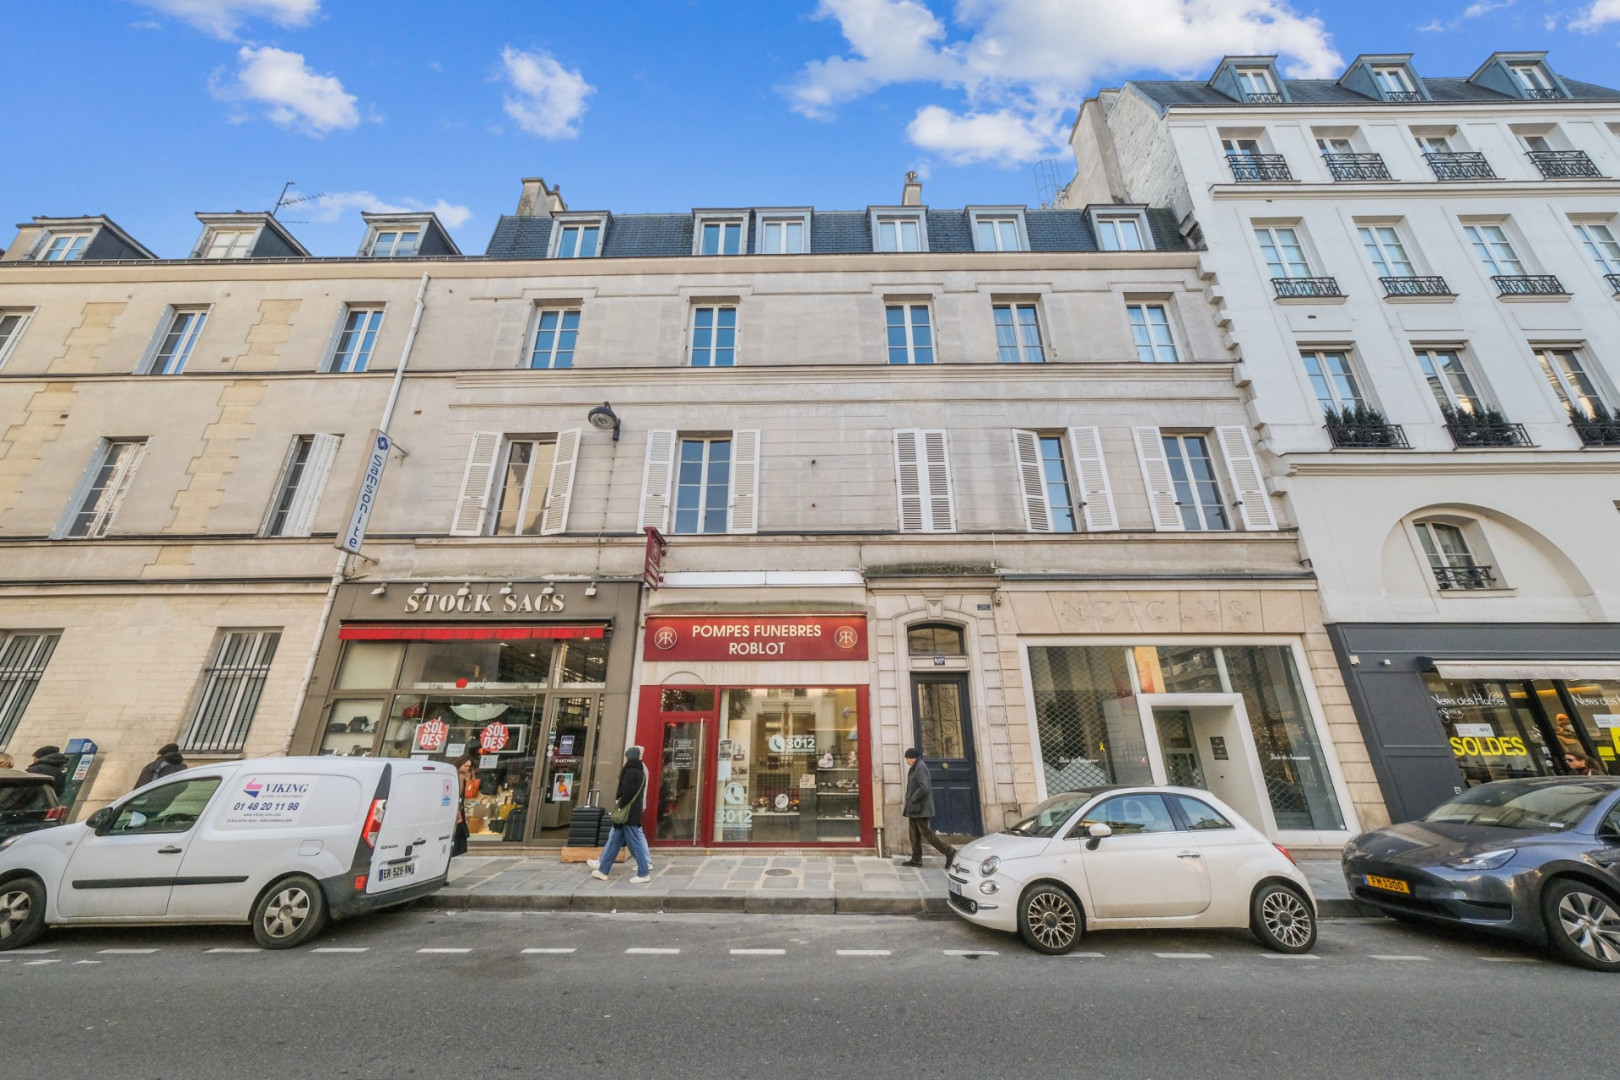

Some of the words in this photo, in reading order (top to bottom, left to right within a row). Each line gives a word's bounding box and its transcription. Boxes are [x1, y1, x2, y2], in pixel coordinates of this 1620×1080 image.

[349, 454, 383, 548] Samsonite
[404, 593, 493, 612] STOCK
[503, 593, 565, 612] SACS
[692, 625, 750, 638] POMPES
[753, 624, 822, 637] FUNEBRES
[729, 642, 785, 655] ROBLOT
[424, 721, 443, 734] SOL
[485, 724, 505, 737] SOL
[420, 733, 441, 746] DES
[483, 737, 505, 749] DES
[786, 738, 815, 749] 3012
[1449, 736, 1528, 756] SOLDES
[266, 783, 309, 793] VIKING
[234, 802, 246, 811] 01
[248, 802, 259, 811] 48
[260, 802, 272, 811] 20
[275, 802, 285, 811] 11
[288, 802, 300, 811] 98
[717, 809, 752, 823] 3012
